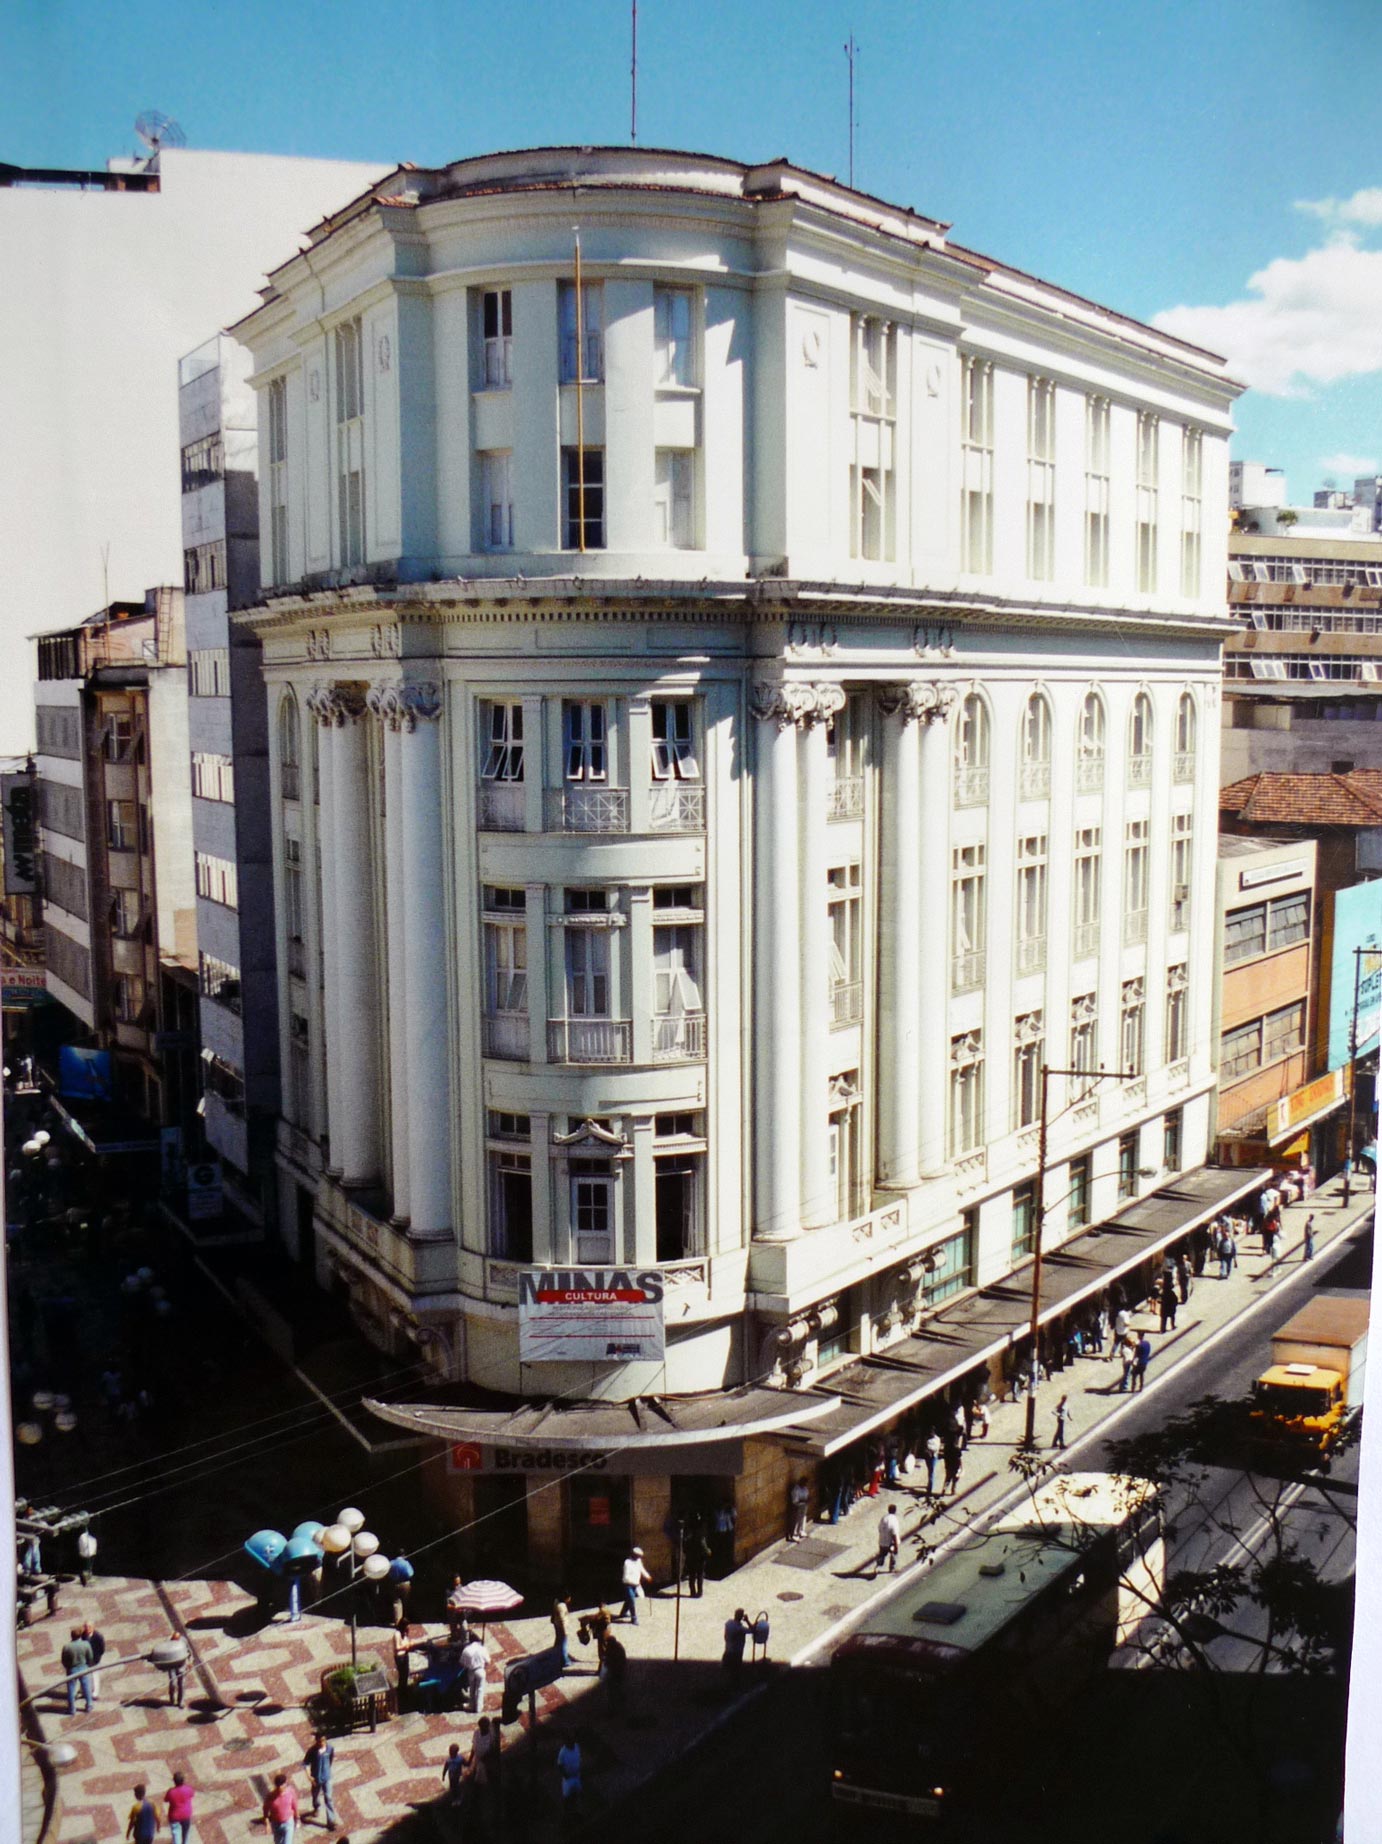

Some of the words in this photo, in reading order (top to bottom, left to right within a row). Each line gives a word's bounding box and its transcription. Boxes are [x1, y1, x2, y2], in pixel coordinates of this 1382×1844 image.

[520, 1272, 664, 1304] MINAS
[565, 1292, 617, 1300] CULTURA
[495, 1449, 608, 1469] Bradesco
